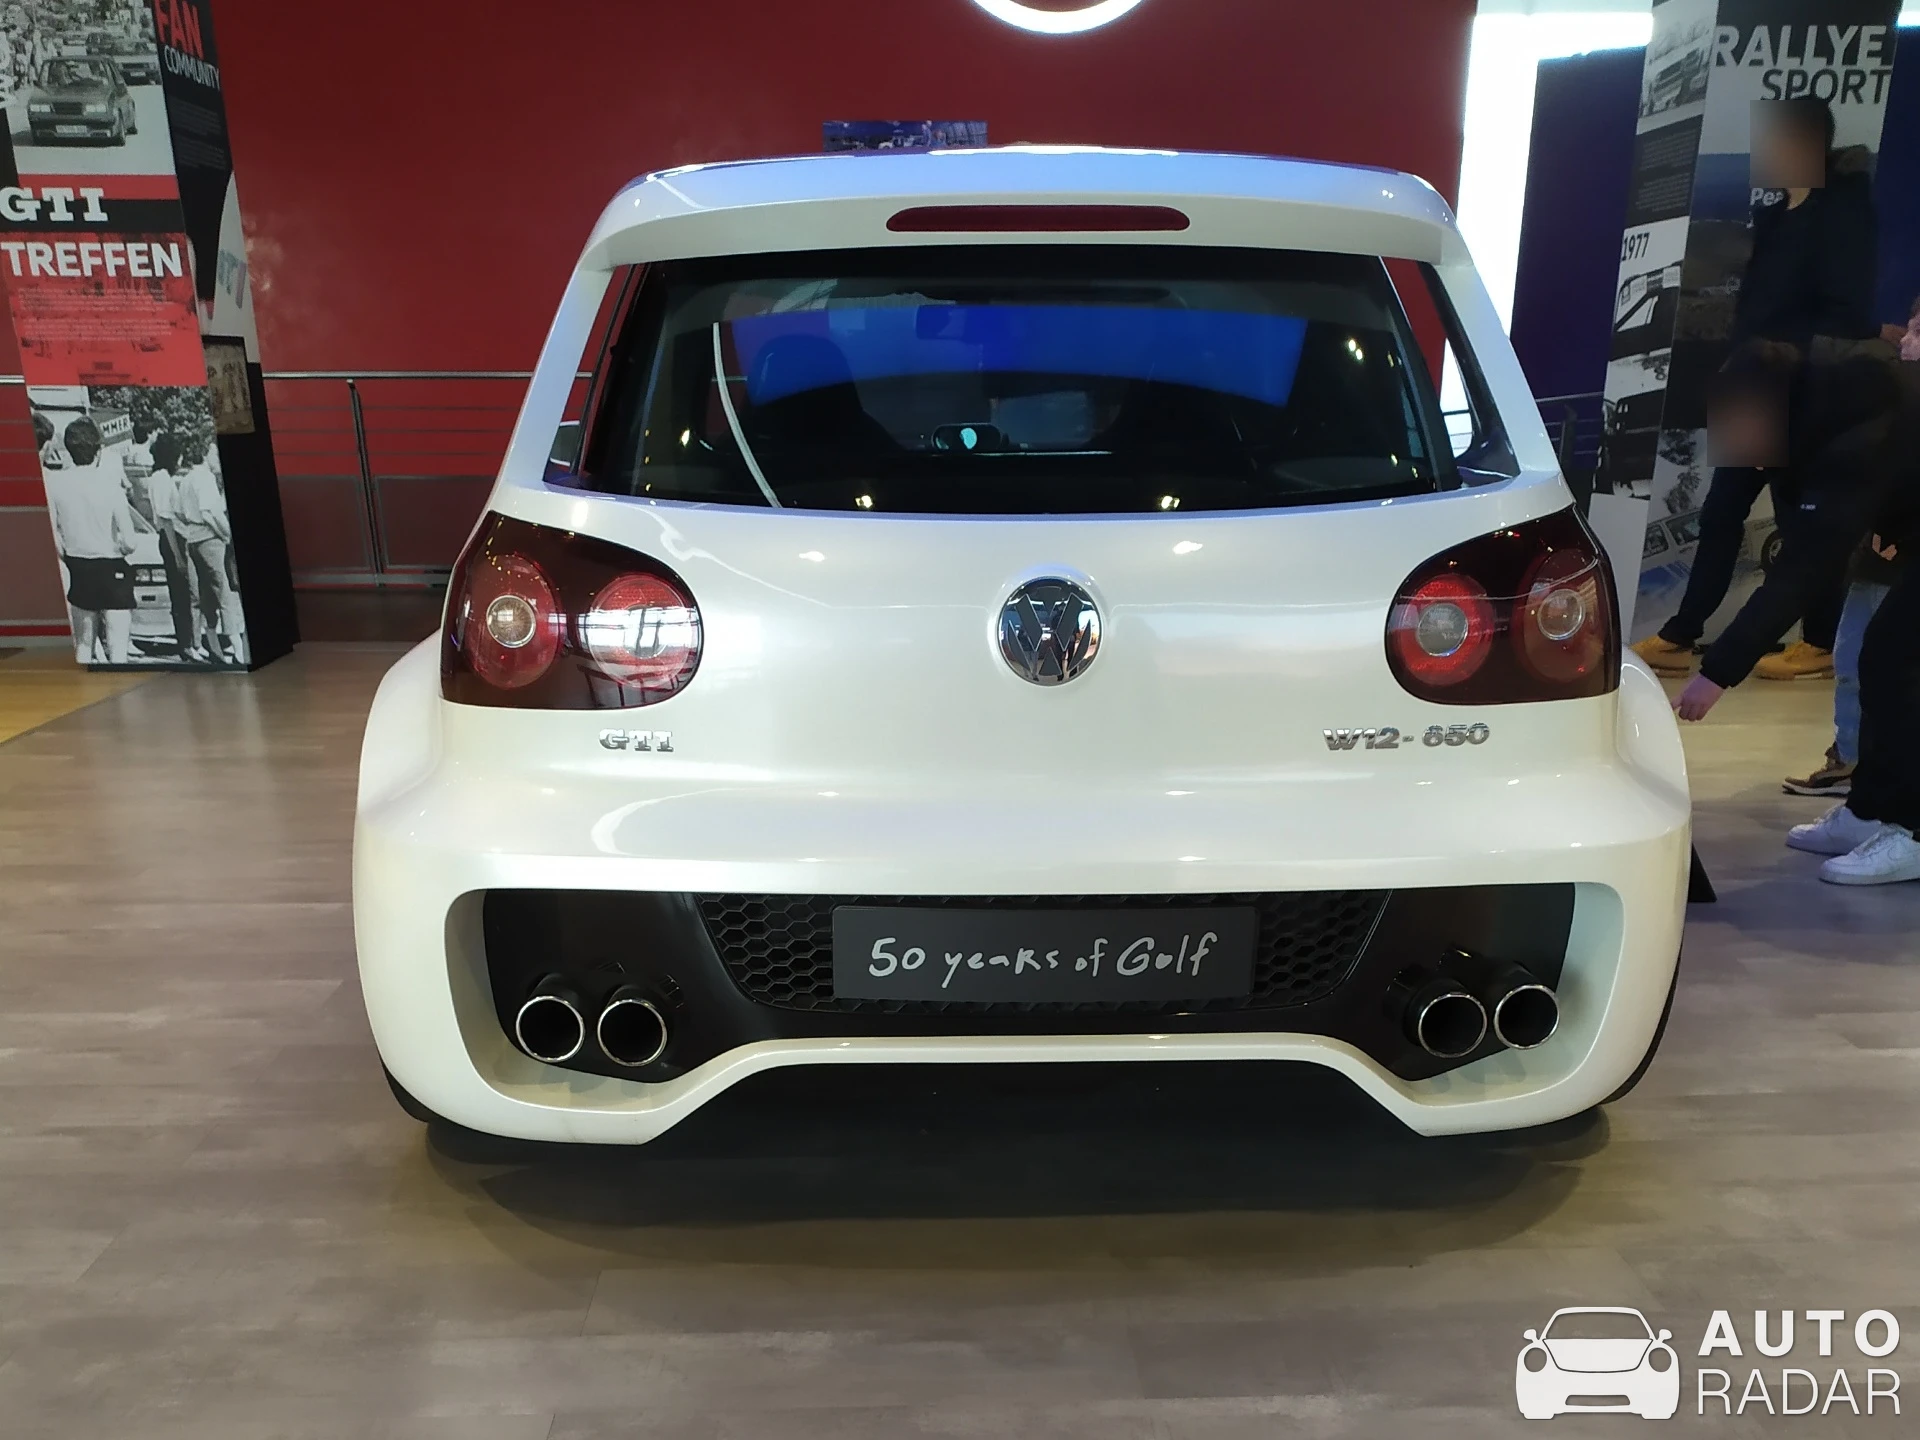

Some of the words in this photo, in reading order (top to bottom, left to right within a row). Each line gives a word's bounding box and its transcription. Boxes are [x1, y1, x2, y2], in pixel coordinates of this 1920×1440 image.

[154, 0, 204, 60] FAN
[1711, 25, 1893, 67] RALLYE
[164, 45, 220, 90] COMMUNITY
[1760, 68, 1893, 104] SPORT
[0, 187, 109, 222] GTI
[0, 242, 183, 278] TREFFEN
[1621, 232, 1650, 261] 1977
[599, 728, 674, 752] GTI
[868, 937, 926, 977] 50
[1075, 938, 1108, 977] of
[1117, 932, 1218, 977] Golf
